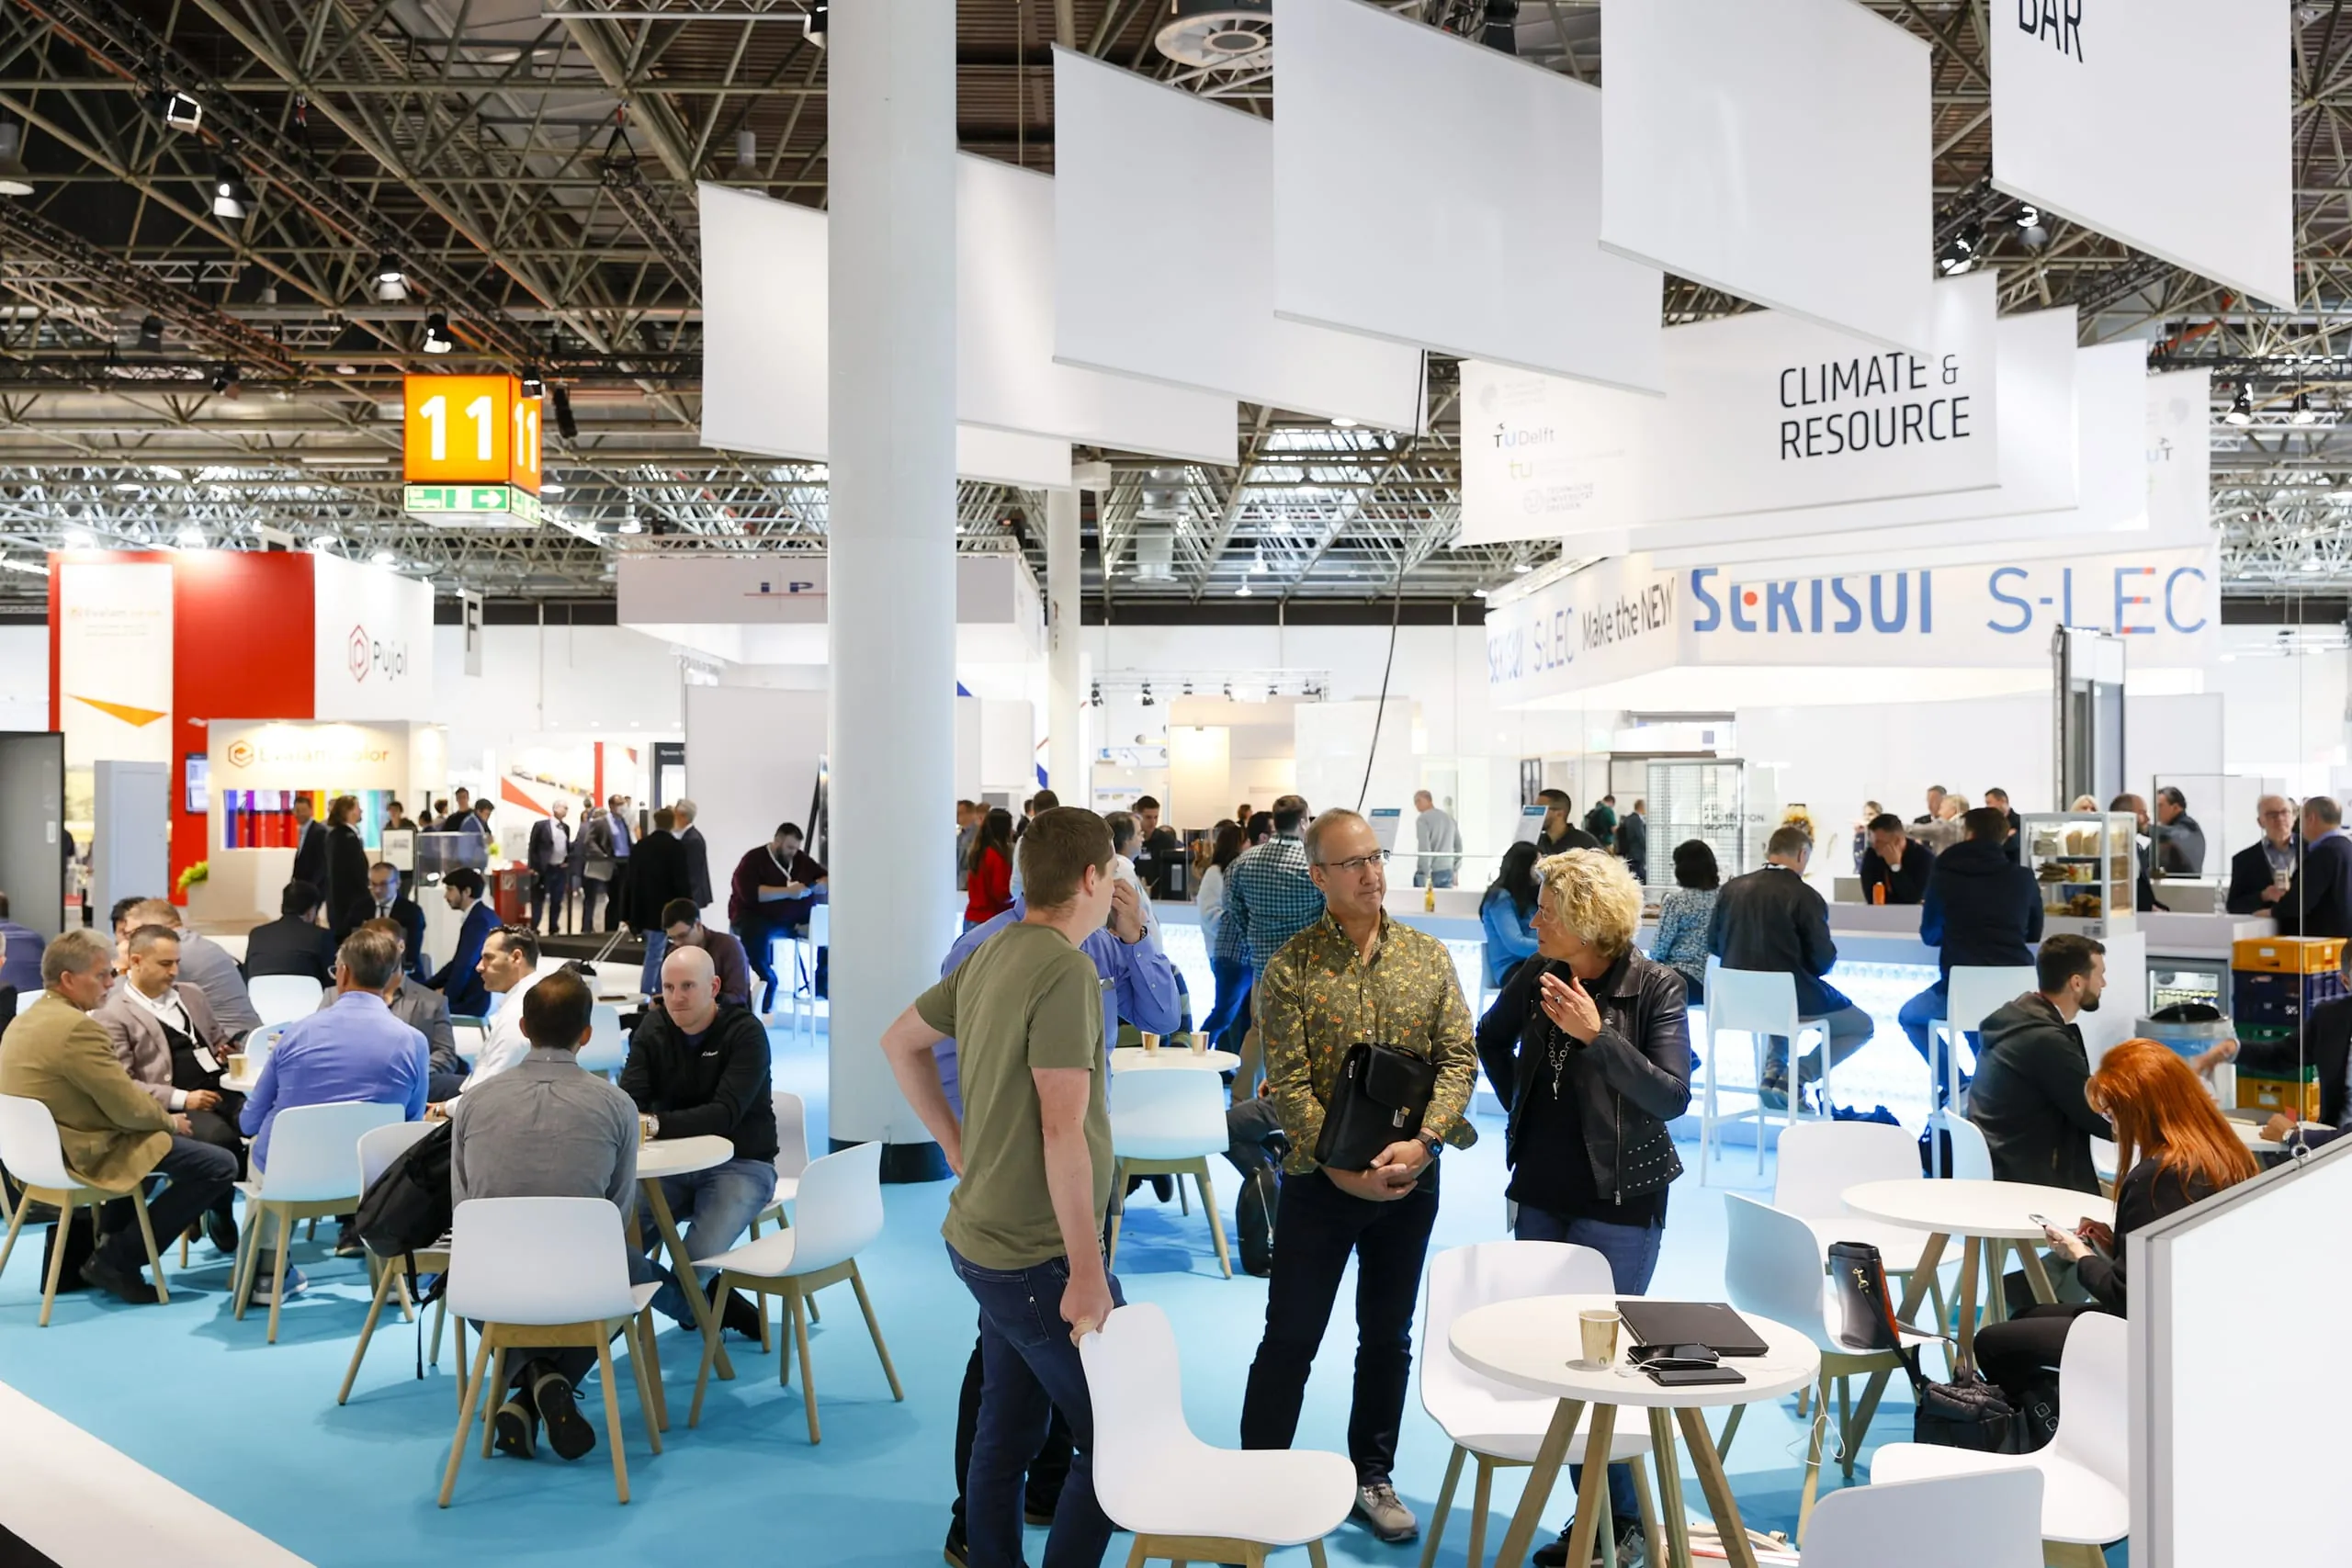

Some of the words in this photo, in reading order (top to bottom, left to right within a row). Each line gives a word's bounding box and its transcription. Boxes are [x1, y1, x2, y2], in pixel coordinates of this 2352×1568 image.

[2018, 0, 2084, 62] BAR
[1781, 352, 1928, 408] CLIMATE
[1942, 355, 1959, 385] &
[419, 395, 492, 460] 11
[514, 401, 537, 473] 11
[1781, 396, 1971, 460] RESOURCE
[1582, 604, 1613, 651] Make
[1615, 596, 1638, 640] the
[1641, 577, 1675, 633] NEW
[1986, 567, 2207, 634] S-LEC
[373, 640, 408, 682] Pujol
